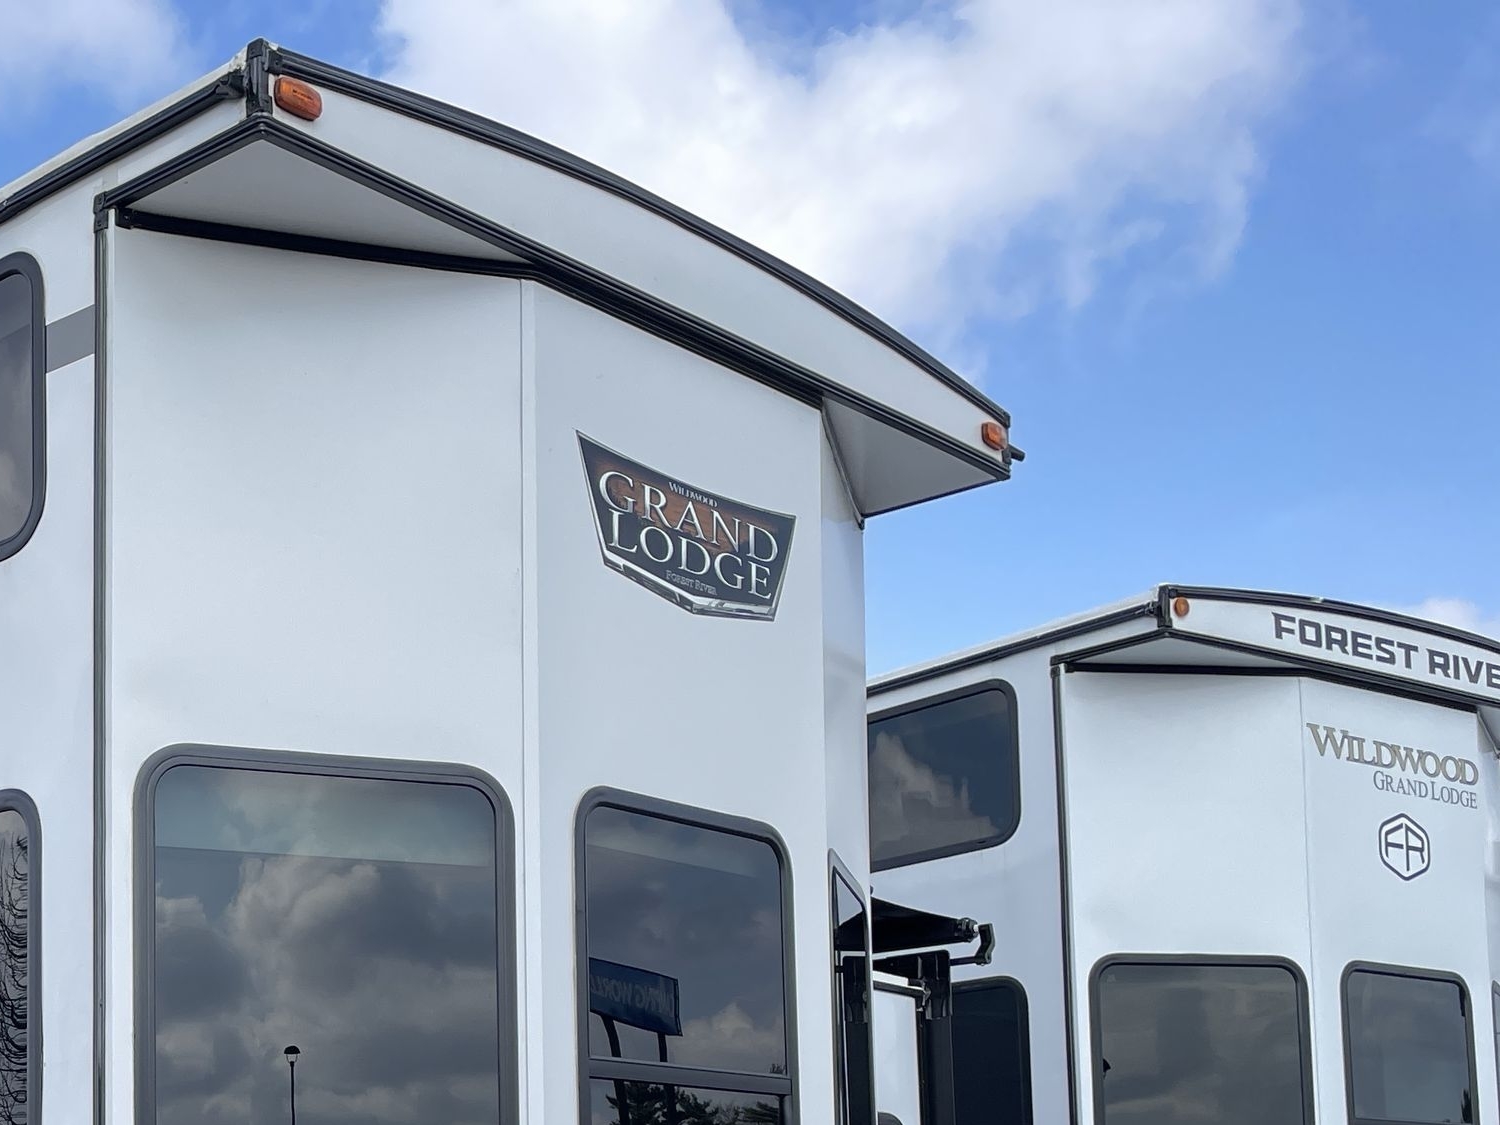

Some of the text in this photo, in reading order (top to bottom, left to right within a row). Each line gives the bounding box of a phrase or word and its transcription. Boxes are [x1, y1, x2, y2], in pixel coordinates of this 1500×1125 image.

[599, 470, 779, 563] GRAND
[607, 508, 772, 600] LODGE
[665, 569, 695, 588] FOREST
[1271, 612, 1419, 669] FOREST
[1306, 722, 1479, 786] WILDWOOD
[1372, 769, 1479, 810] GRAND LODGE
